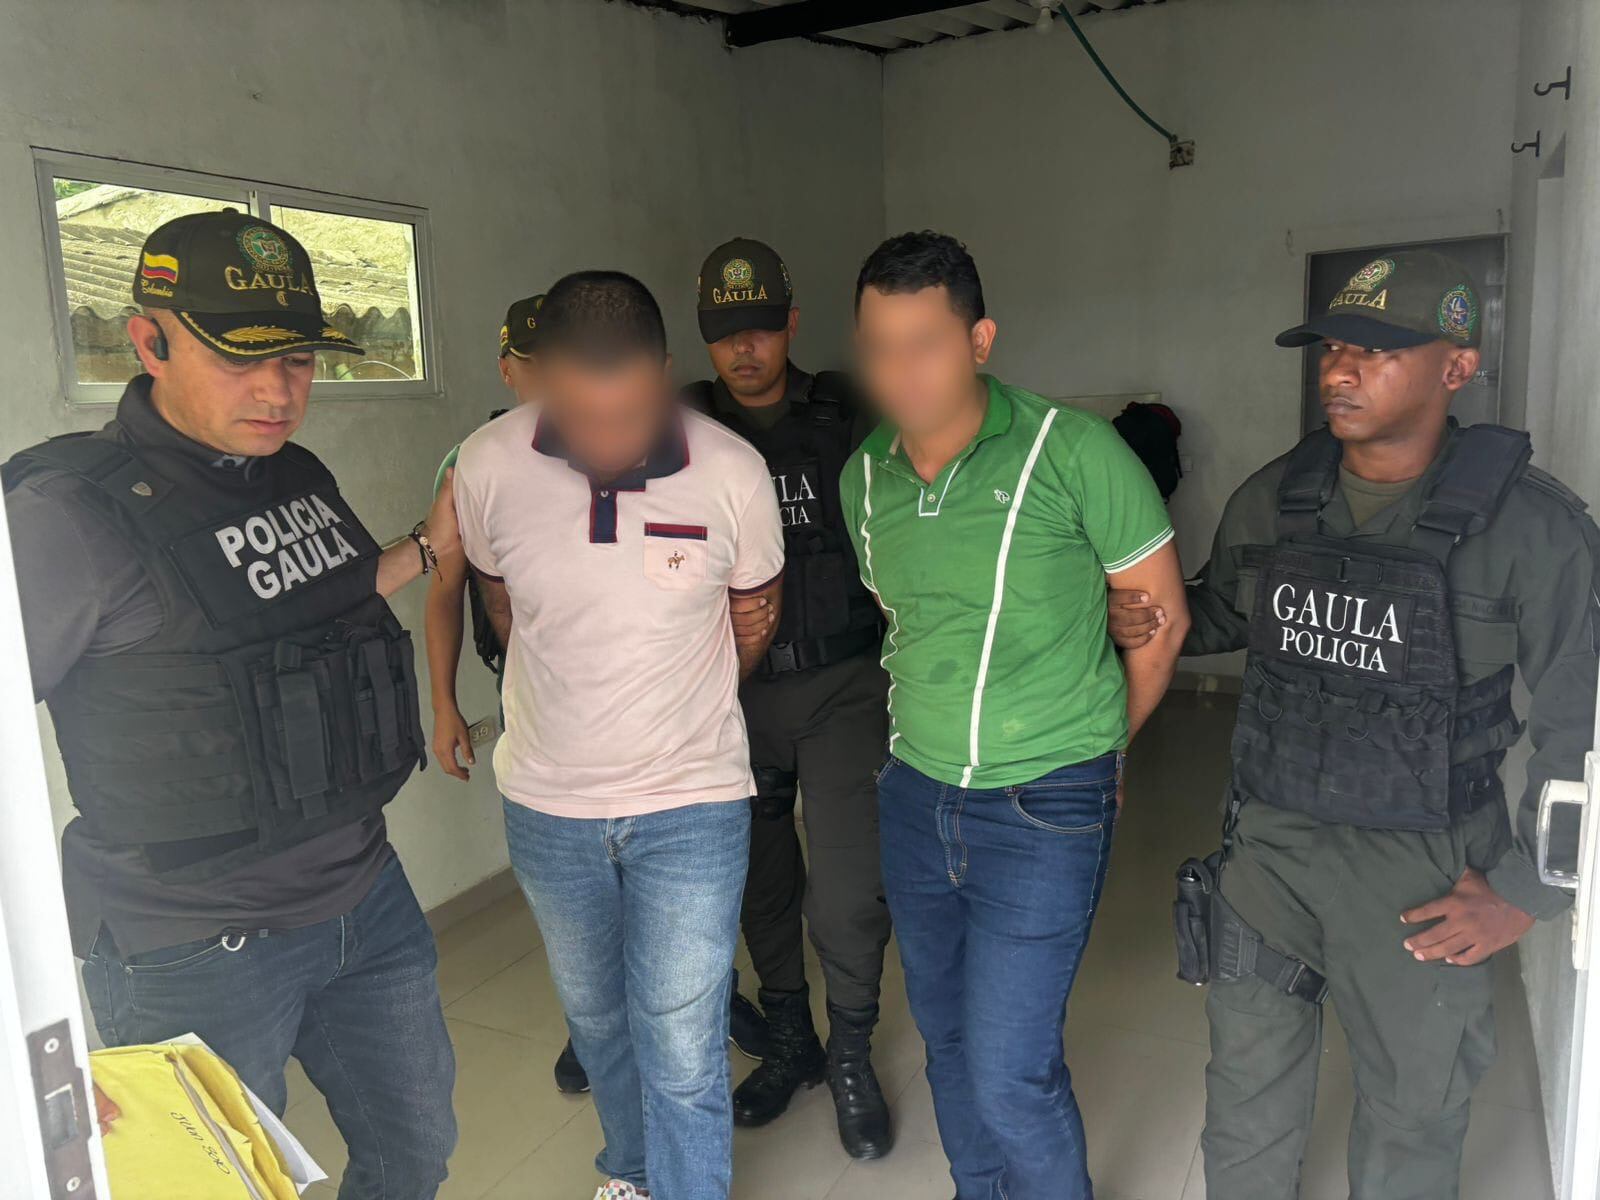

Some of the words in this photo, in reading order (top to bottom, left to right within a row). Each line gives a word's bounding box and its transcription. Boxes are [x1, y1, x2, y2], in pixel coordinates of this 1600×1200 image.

[224, 266, 314, 295] GAULA
[712, 284, 768, 304] GAULA
[214, 494, 343, 568] POLICIA
[247, 527, 359, 599] GAULA
[1272, 583, 1404, 644] GAULA
[1279, 626, 1388, 673] POLICIA
